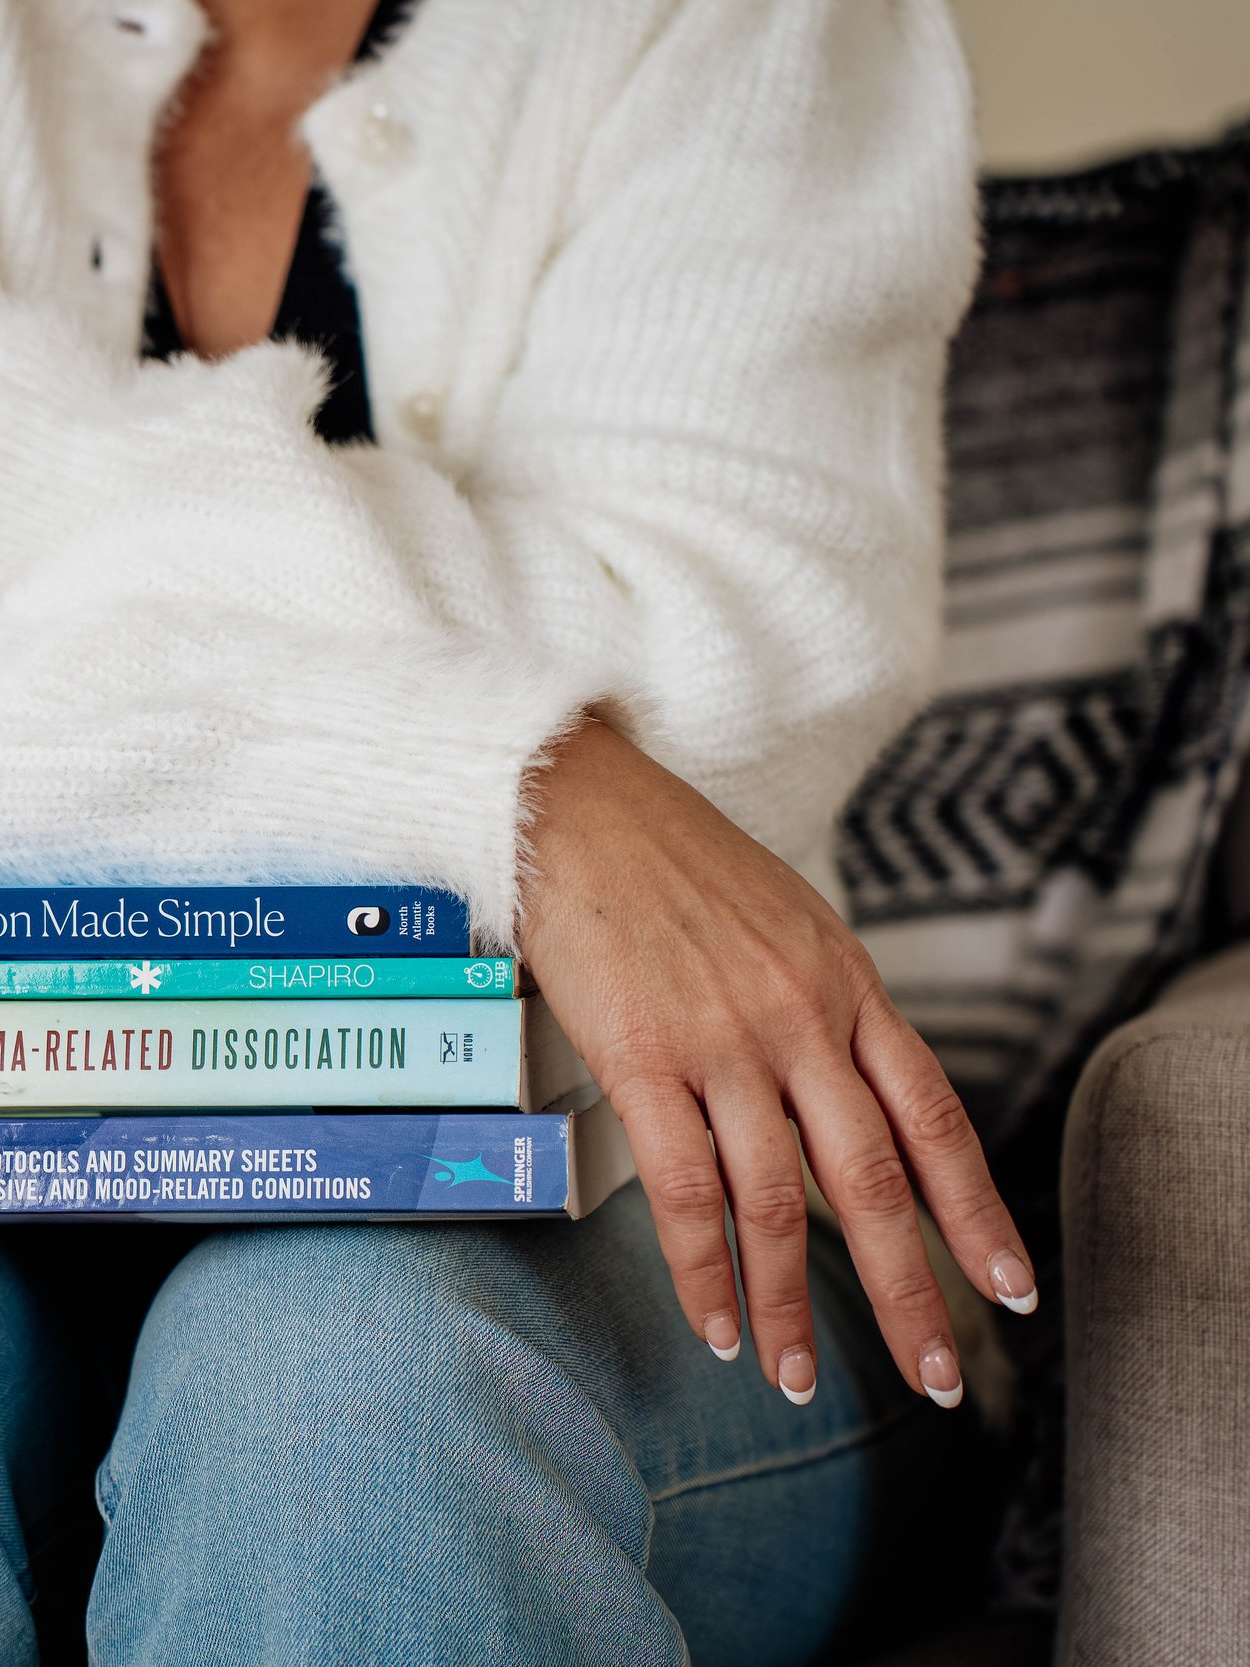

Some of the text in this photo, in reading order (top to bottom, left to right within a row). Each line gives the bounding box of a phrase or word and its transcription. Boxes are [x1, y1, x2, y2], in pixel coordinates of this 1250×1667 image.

[41, 898, 149, 938] Made
[158, 898, 285, 947] Simple
[399, 906, 408, 936] North
[412, 900, 422, 941] Atlantic
[425, 905, 435, 936] Books
[249, 963, 375, 988] SHAPIRO
[495, 961, 505, 988] IHB
[191, 1026, 406, 1071] DISSOCIATION
[463, 1033, 473, 1062] NORTON
[86, 1149, 127, 1173] AND
[133, 1149, 235, 1173] SUMMARY
[240, 1148, 317, 1172] SHEETS
[514, 1136, 525, 1202] SPRINGER
[49, 1178, 89, 1201] AND
[94, 1178, 245, 1201] MOOD-RELATED
[250, 1177, 371, 1200] CONDITIONS
